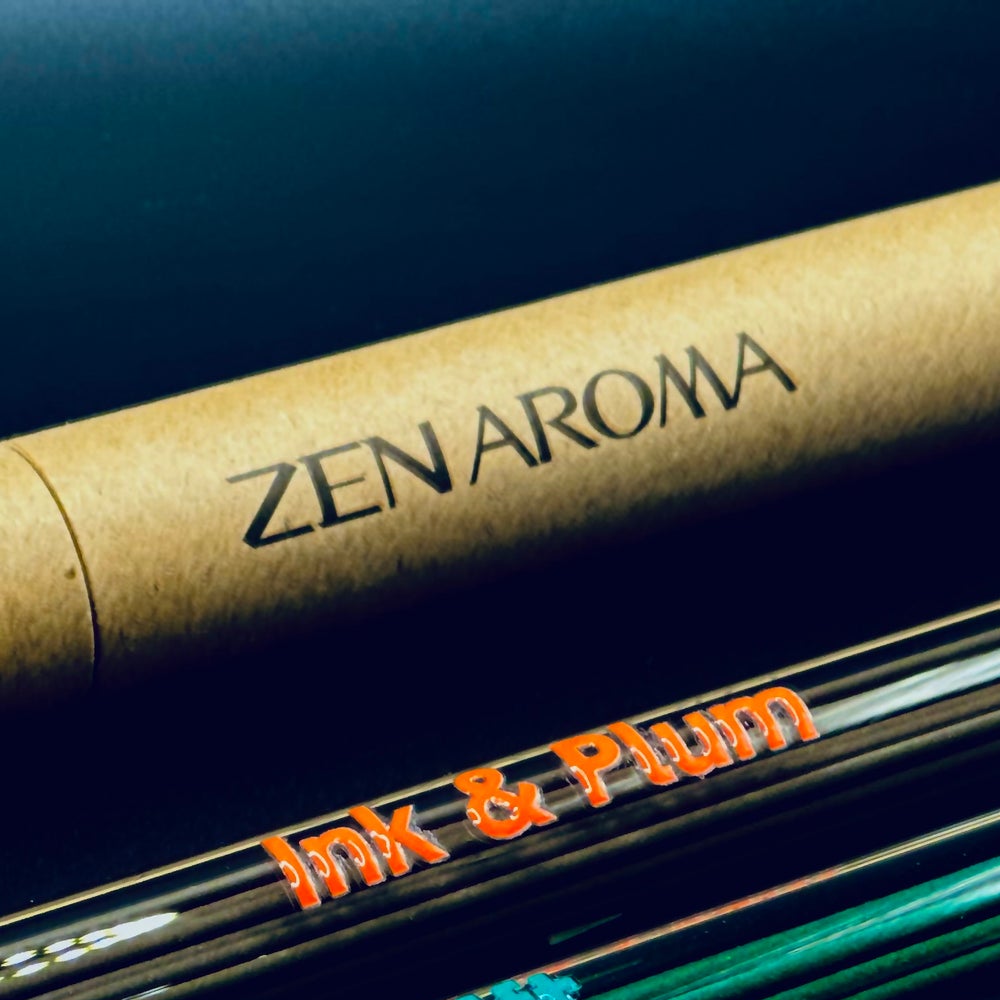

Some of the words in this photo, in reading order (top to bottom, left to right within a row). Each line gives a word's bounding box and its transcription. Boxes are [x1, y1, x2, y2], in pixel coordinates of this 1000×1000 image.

[226, 420, 453, 549] ZEN
[469, 331, 797, 486] AROMA
[261, 803, 450, 910] Ink
[453, 767, 558, 840] &
[549, 686, 820, 807] Plum
